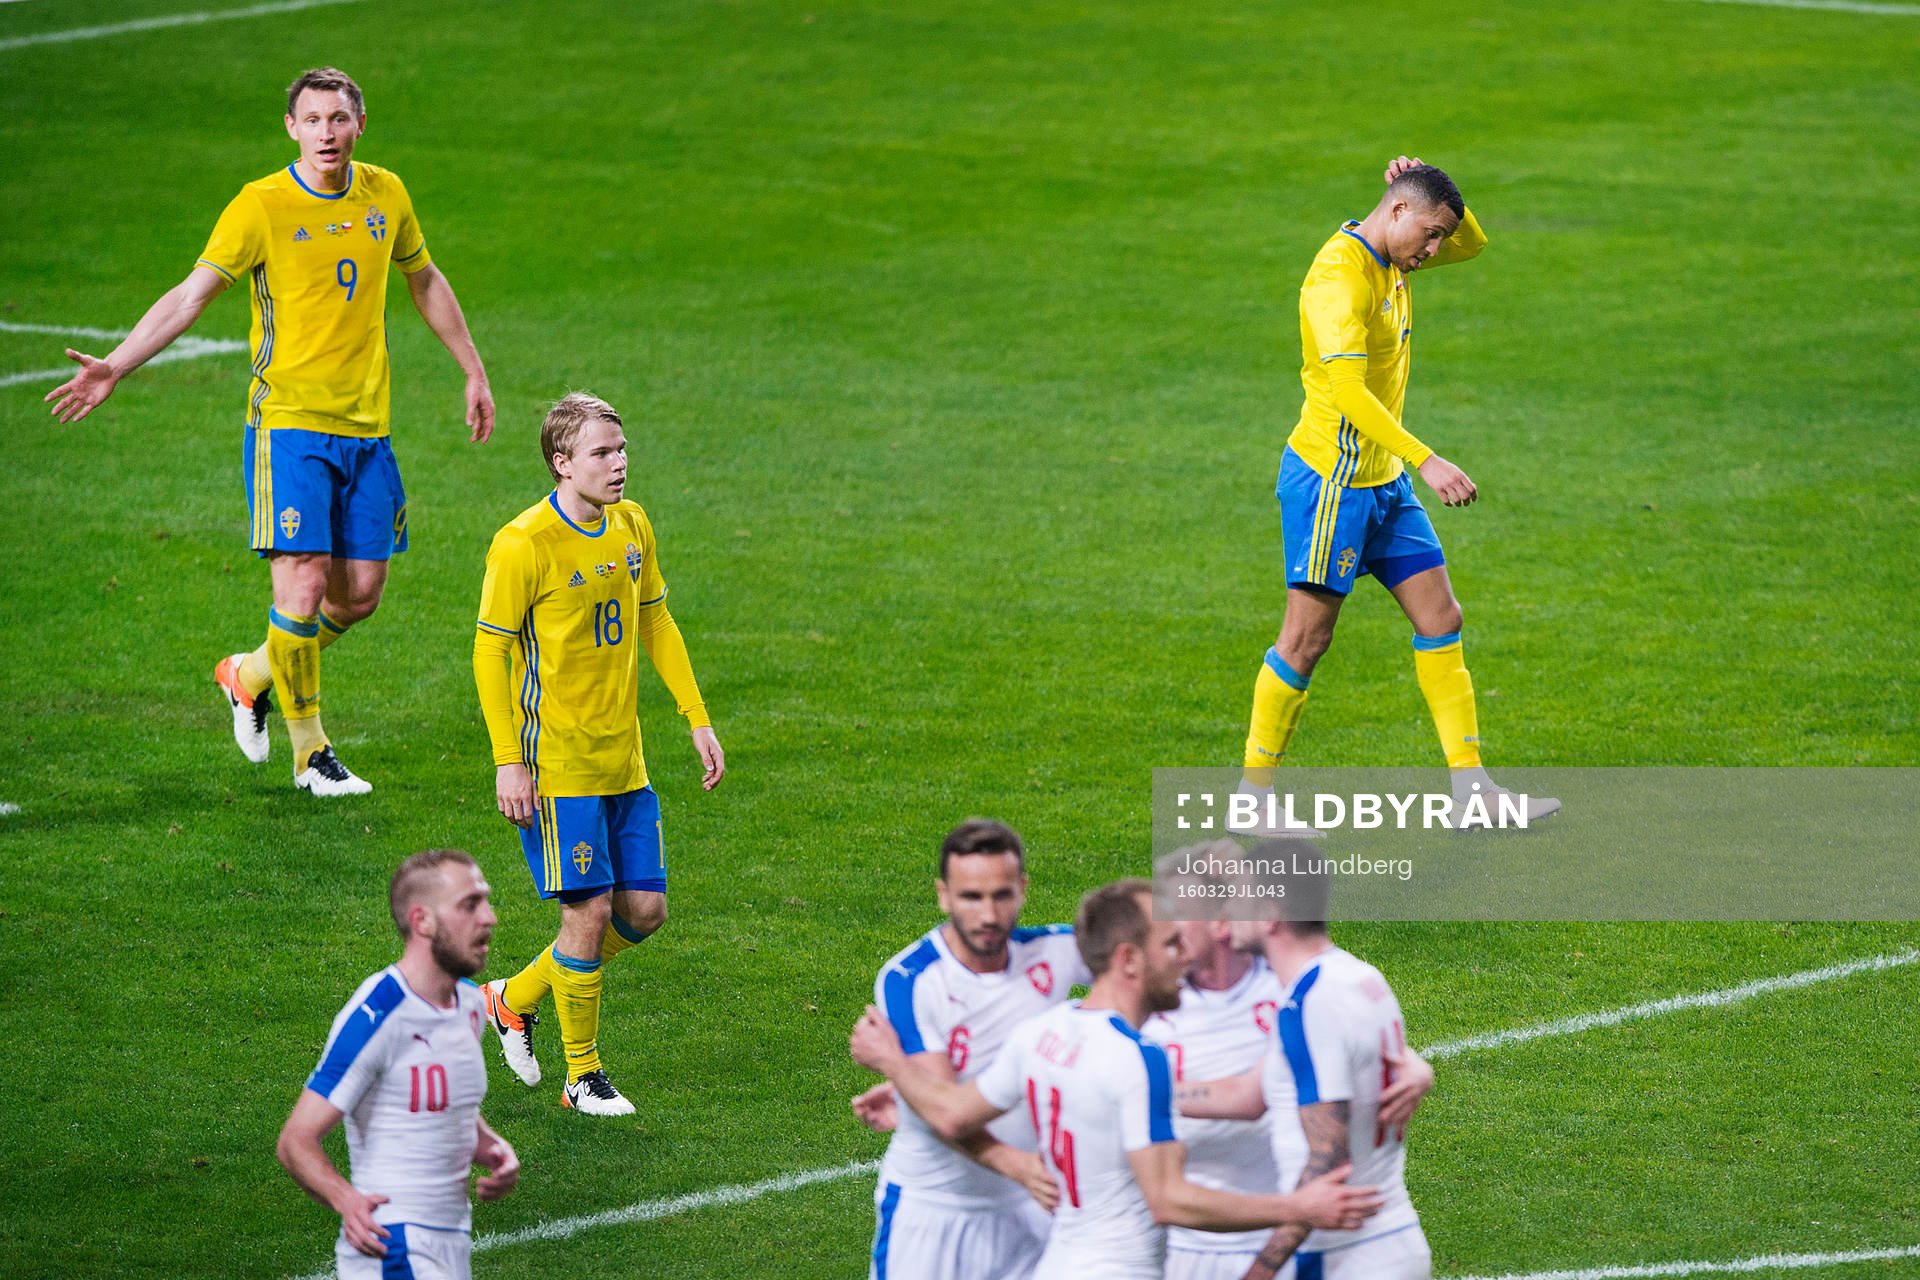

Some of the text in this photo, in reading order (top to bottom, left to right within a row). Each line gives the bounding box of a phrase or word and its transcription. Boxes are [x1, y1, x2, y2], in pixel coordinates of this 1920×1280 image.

[336, 258, 358, 302] 9
[594, 598, 623, 648] 18
[948, 1025, 969, 1072] 6
[409, 1064, 449, 1113] 10
